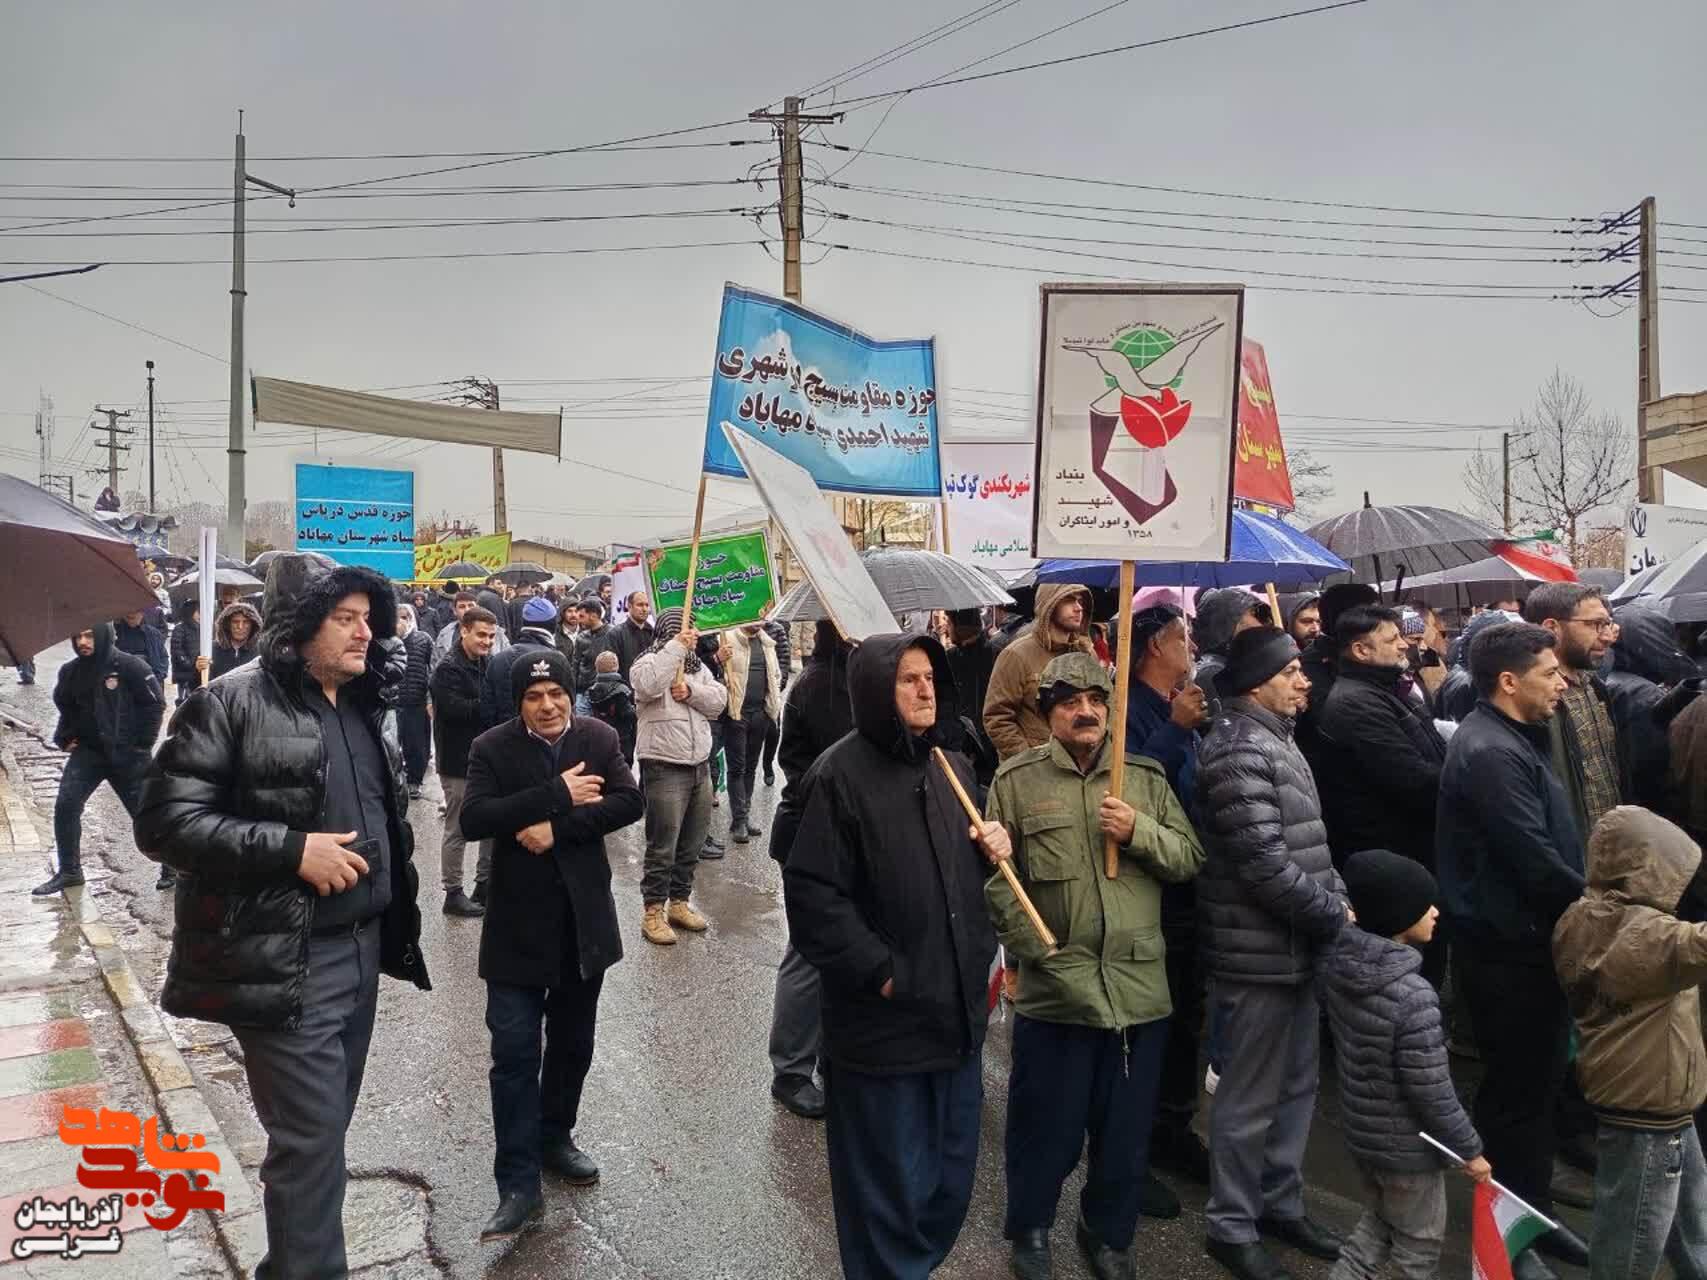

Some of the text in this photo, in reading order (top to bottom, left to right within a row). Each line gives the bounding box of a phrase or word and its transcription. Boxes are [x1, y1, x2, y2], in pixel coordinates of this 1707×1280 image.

[738, 391, 804, 434] مهاباد
[890, 421, 929, 453] شهید
[1055, 468, 1085, 484] بنیاد
[1057, 494, 1113, 510] شهید
[1098, 517, 1121, 529] امور
[1122, 519, 1130, 529] و
[297, 527, 334, 544] مهاباد
[697, 552, 728, 571] حوز
